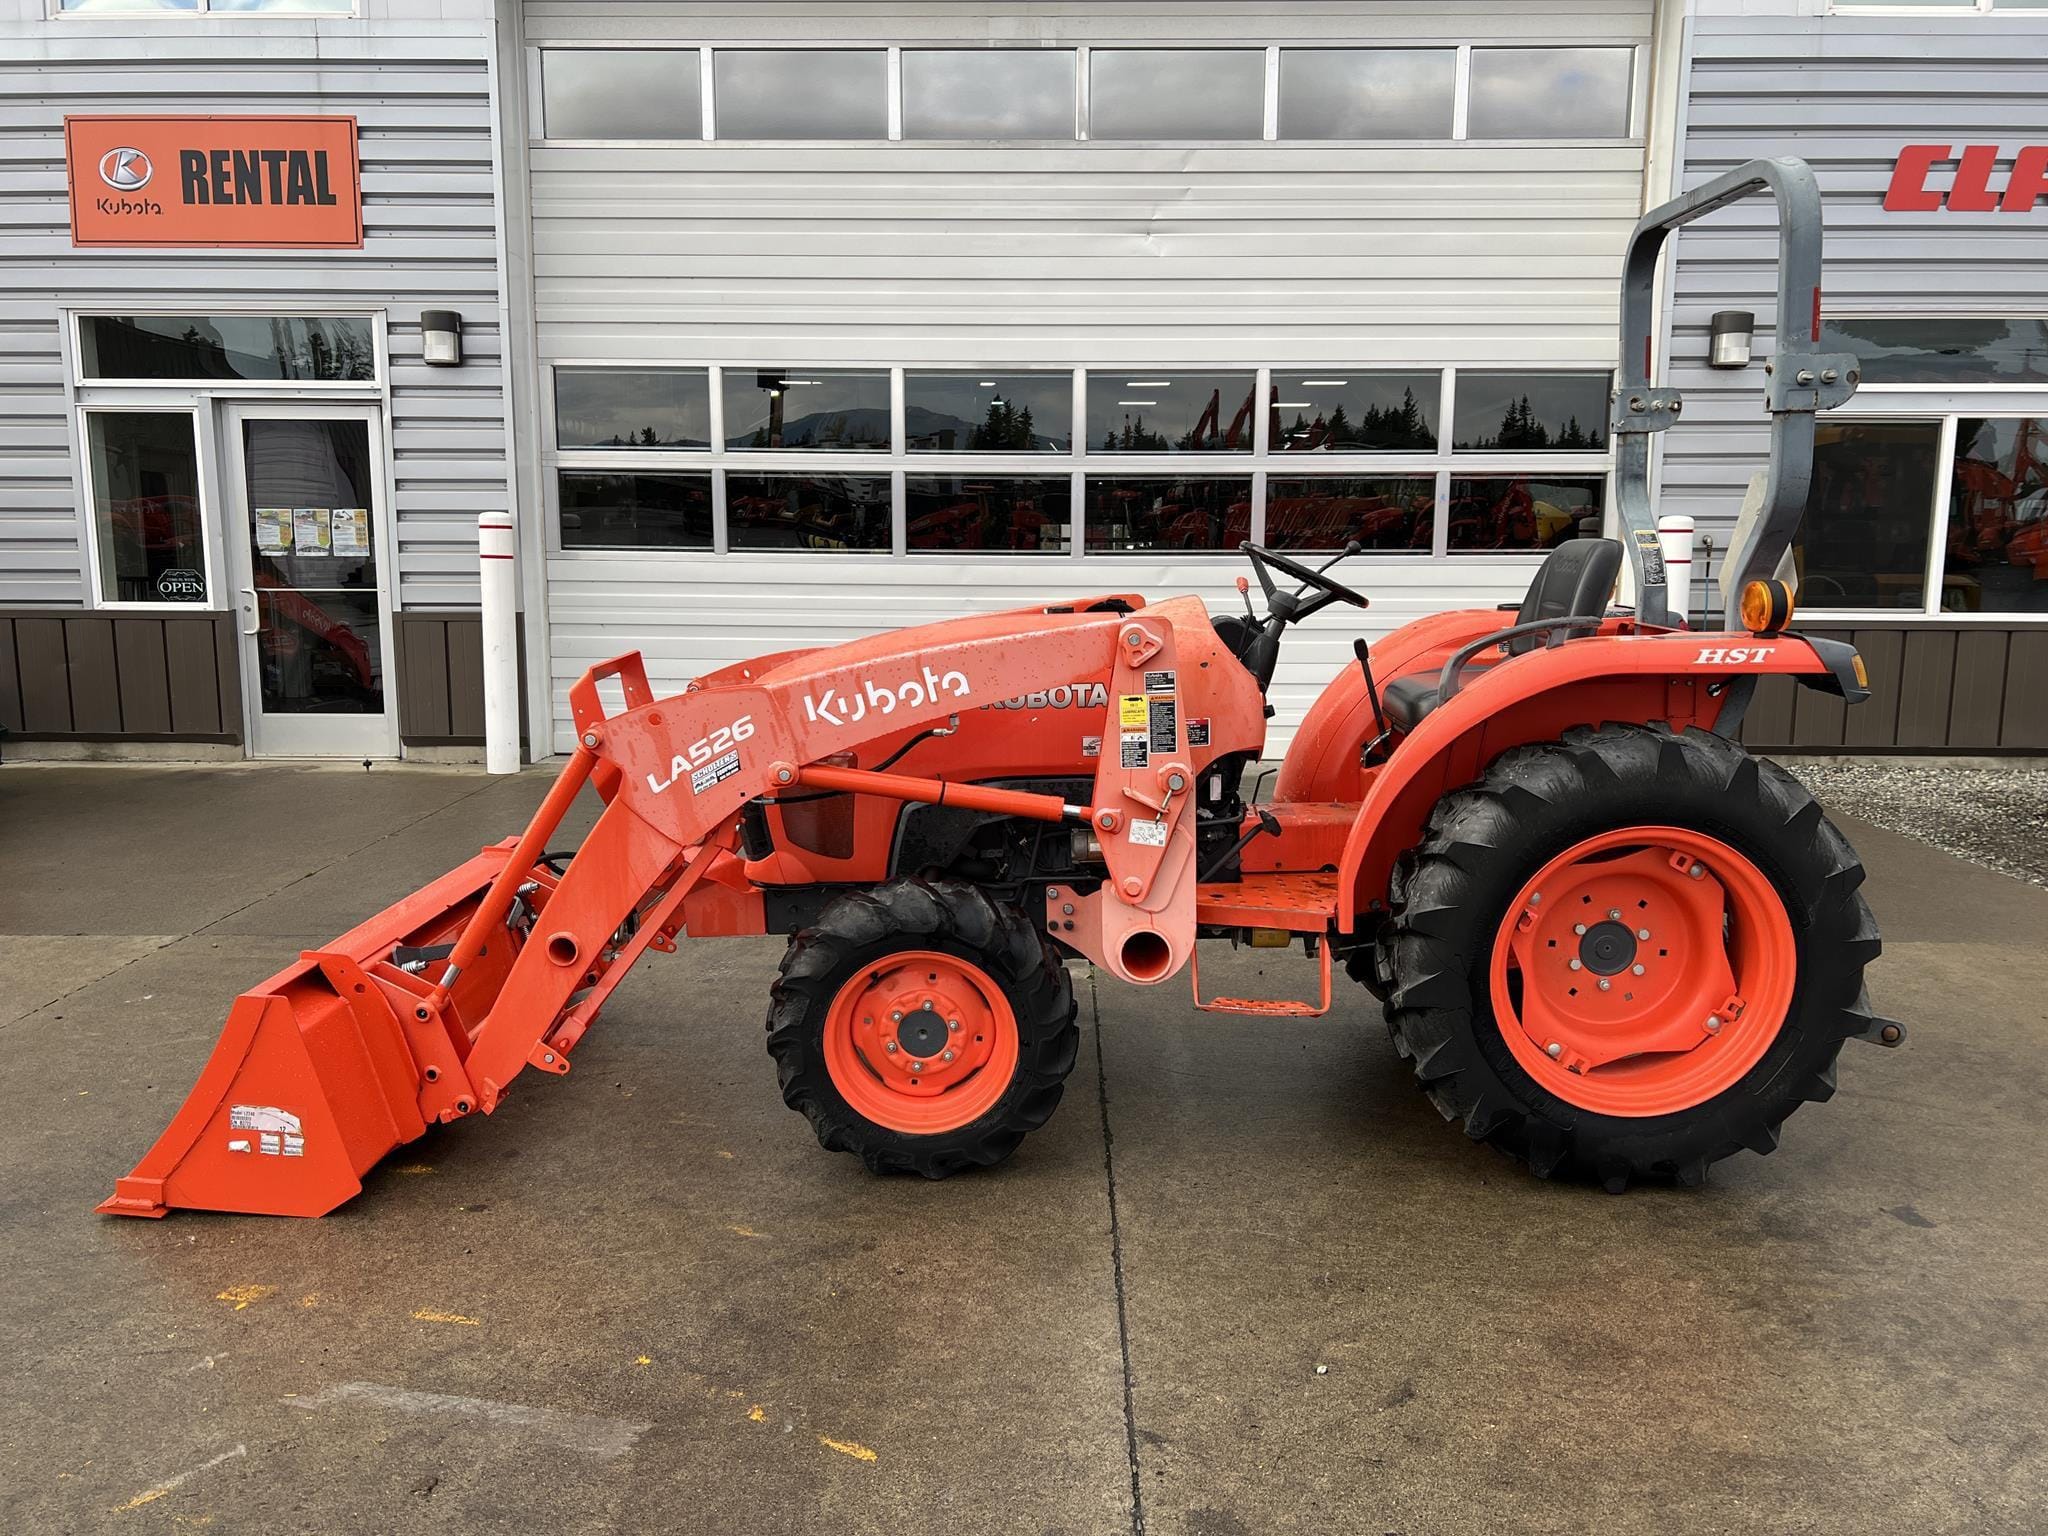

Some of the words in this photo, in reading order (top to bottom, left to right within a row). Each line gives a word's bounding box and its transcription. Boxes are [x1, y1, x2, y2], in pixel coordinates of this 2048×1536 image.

[179, 149, 337, 205] RENTAL
[1883, 145, 2048, 212] CLA
[97, 198, 162, 216] Kubota
[160, 581, 204, 593] OPEN
[1692, 647, 1776, 664] HST
[803, 666, 970, 726] Kubota
[646, 715, 755, 793] LA526
